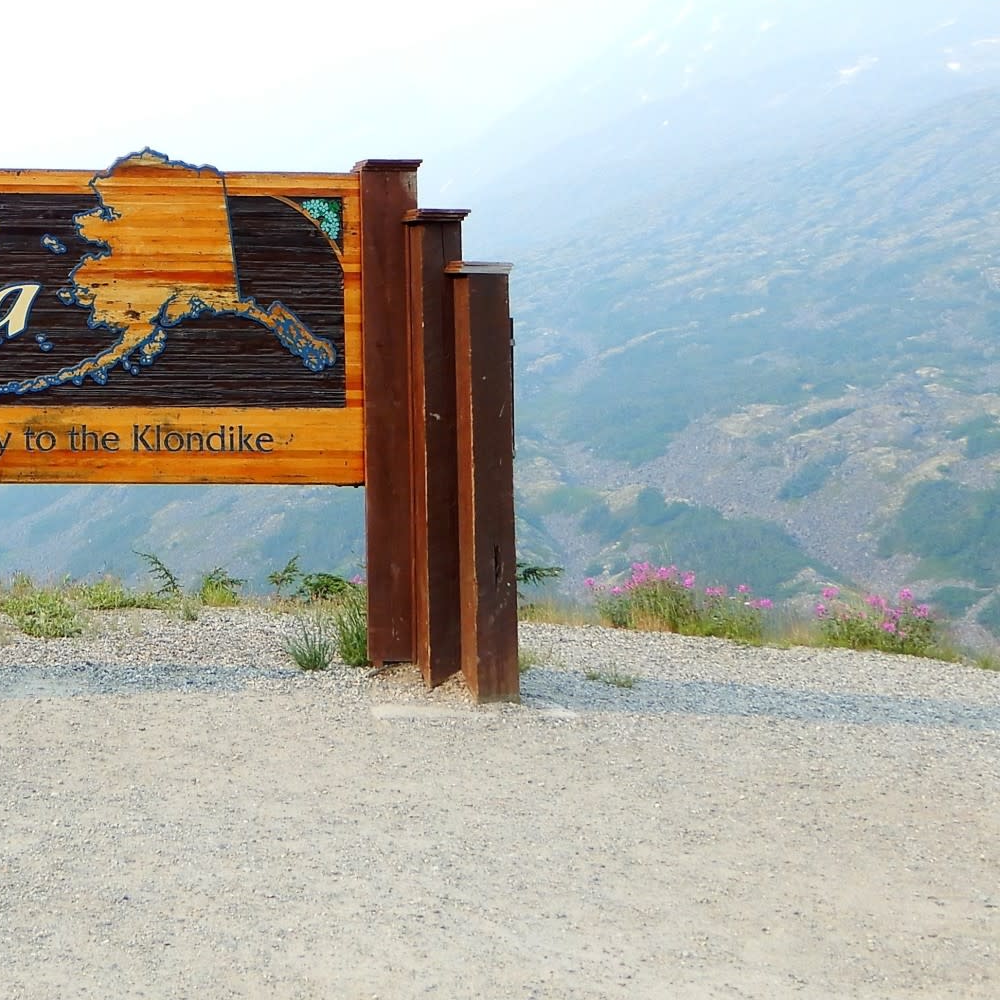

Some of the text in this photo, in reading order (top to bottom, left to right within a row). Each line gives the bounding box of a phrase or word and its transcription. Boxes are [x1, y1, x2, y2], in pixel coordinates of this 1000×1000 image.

[24, 425, 57, 452] to
[68, 425, 120, 452] the
[132, 424, 274, 453] Klondike
